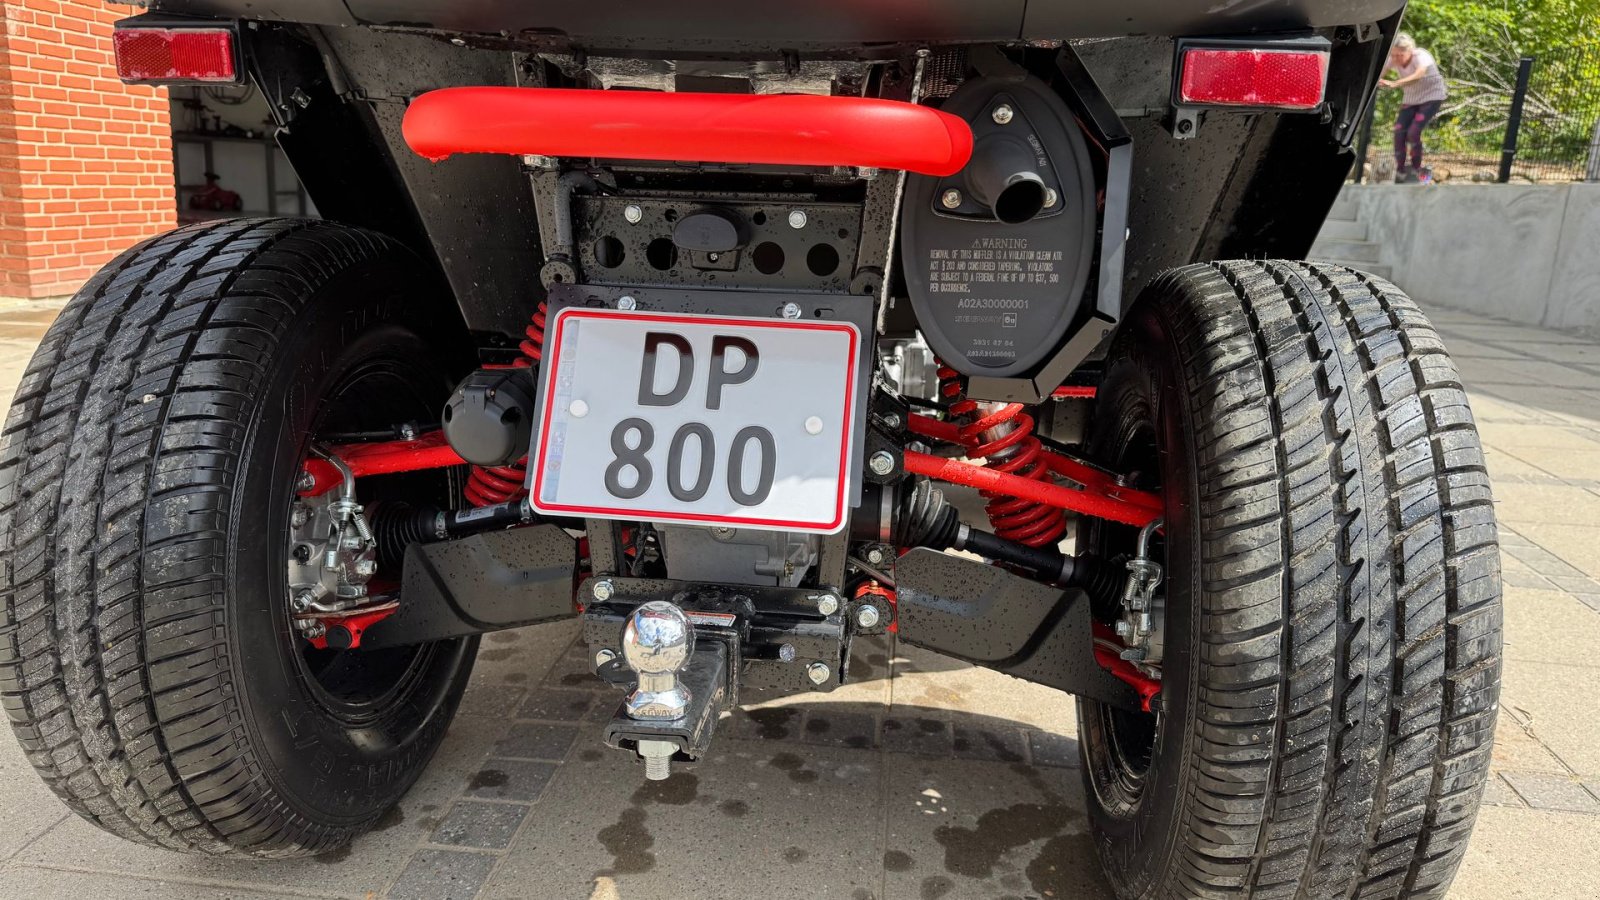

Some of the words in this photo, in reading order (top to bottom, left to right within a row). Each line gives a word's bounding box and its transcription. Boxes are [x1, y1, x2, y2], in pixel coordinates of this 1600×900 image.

[982, 238, 1028, 249] WARNING
[930, 249, 949, 259] REMOVAL
[952, 249, 958, 259] OF
[960, 249, 972, 259] THIS
[973, 250, 993, 260] MUFFLER
[996, 250, 1002, 260] IS
[1008, 251, 1035, 260] VIOLATION
[1037, 251, 1051, 260] CLEAN
[1052, 251, 1063, 261] AIR
[930, 260, 939, 270] ACT
[956, 261, 966, 270] AND
[968, 261, 995, 271] CONSIDERED
[1027, 262, 1053, 272] VIOLATORS
[930, 271, 939, 281] ARE
[941, 271, 960, 281] SUBJECT
[962, 272, 969, 281] TO
[975, 272, 995, 282] FEDERAL
[997, 273, 1009, 282] FINE
[1011, 273, 1017, 282] OF
[1019, 273, 1025, 282] UP
[1027, 273, 1034, 282] TO
[930, 282, 939, 292] PER
[941, 283, 971, 293] OCCURRENCE.
[637, 331, 759, 411] DP
[604, 417, 777, 507] 800
